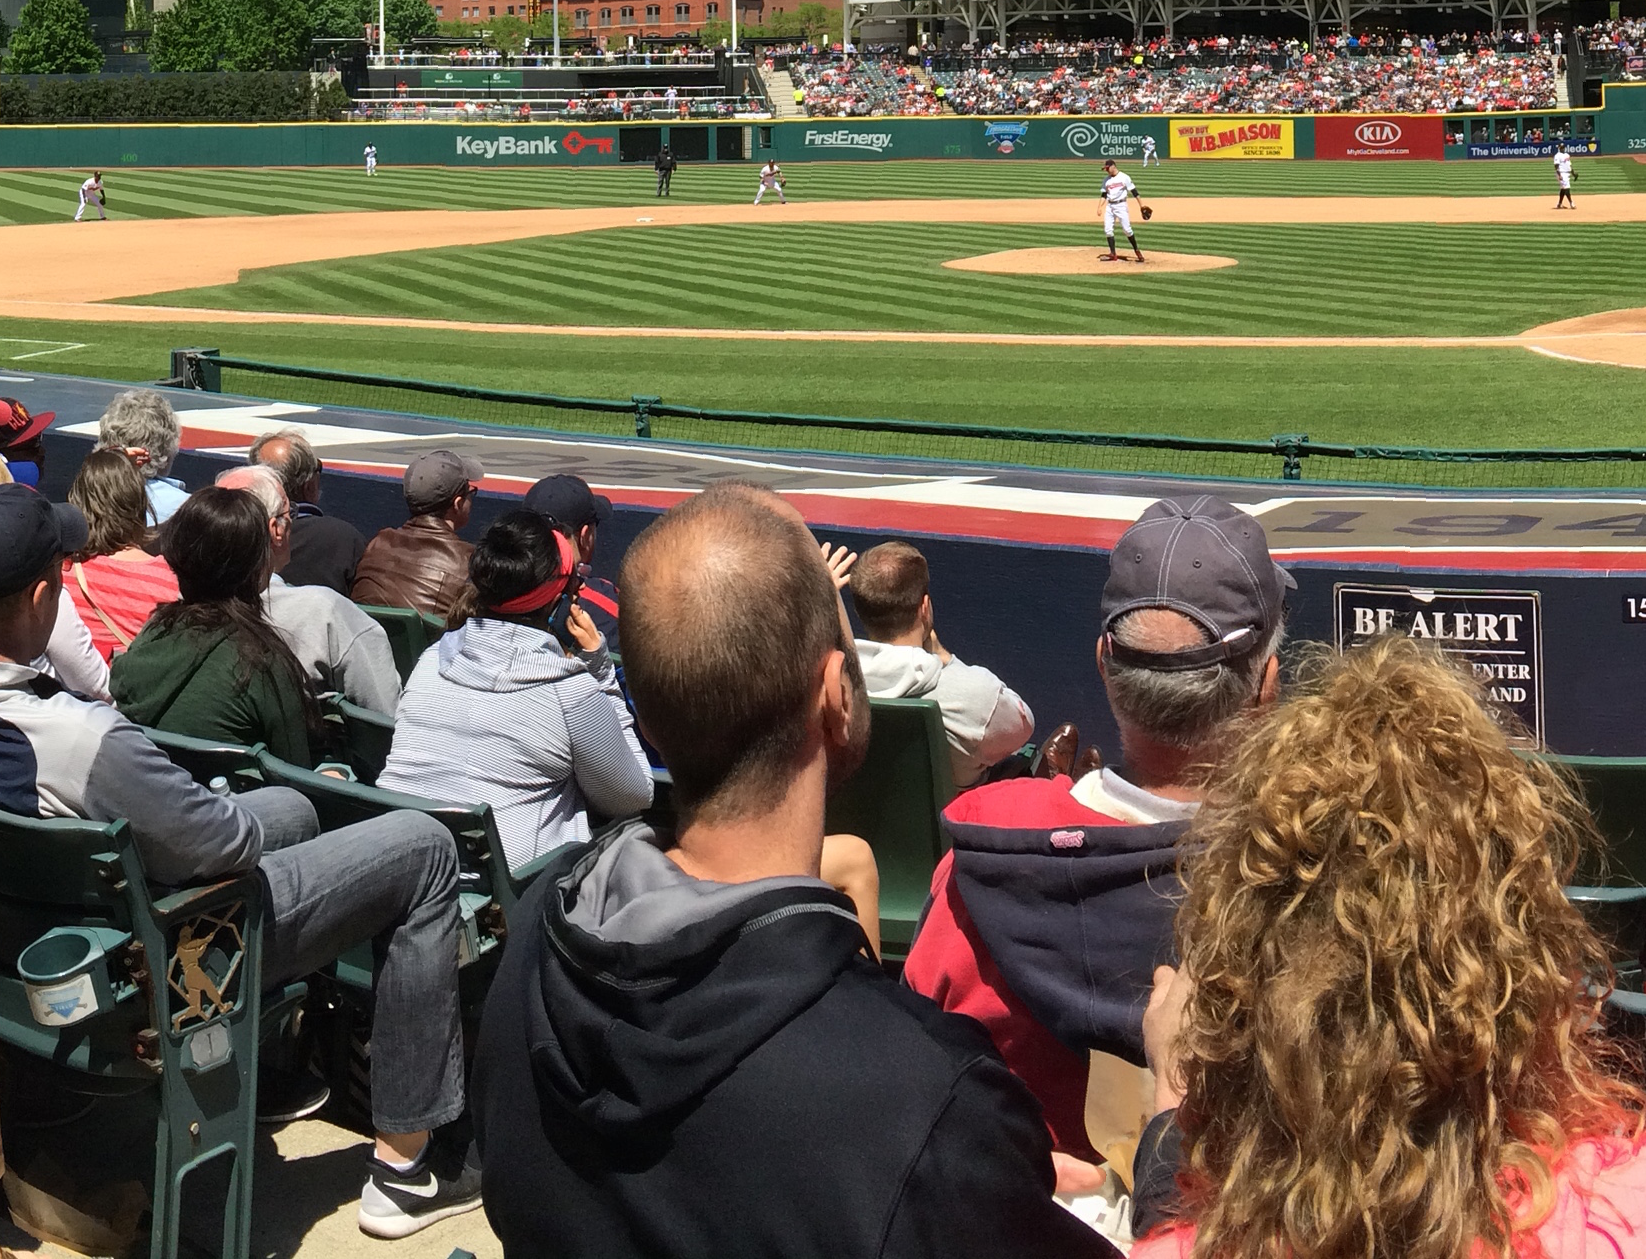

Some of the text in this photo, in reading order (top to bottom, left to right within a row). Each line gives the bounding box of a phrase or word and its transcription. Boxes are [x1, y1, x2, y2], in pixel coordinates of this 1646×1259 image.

[1100, 121, 1121, 133] Time
[1178, 125, 1210, 137] WHO BUT
[1363, 126, 1393, 140] KIA
[805, 129, 892, 150] FirstEnergy
[1100, 132, 1144, 145] Warner
[1628, 138, 1646, 149] 325
[456, 136, 558, 160] KeyBank
[1100, 144, 1134, 156] Cable
[1346, 148, 1410, 156] MyKiaCleveland.com
[1471, 145, 1552, 159] The University of
[1353, 607, 1523, 642] BE ALERT
[1473, 663, 1531, 680] ENTER
[1487, 687, 1527, 703] AND
